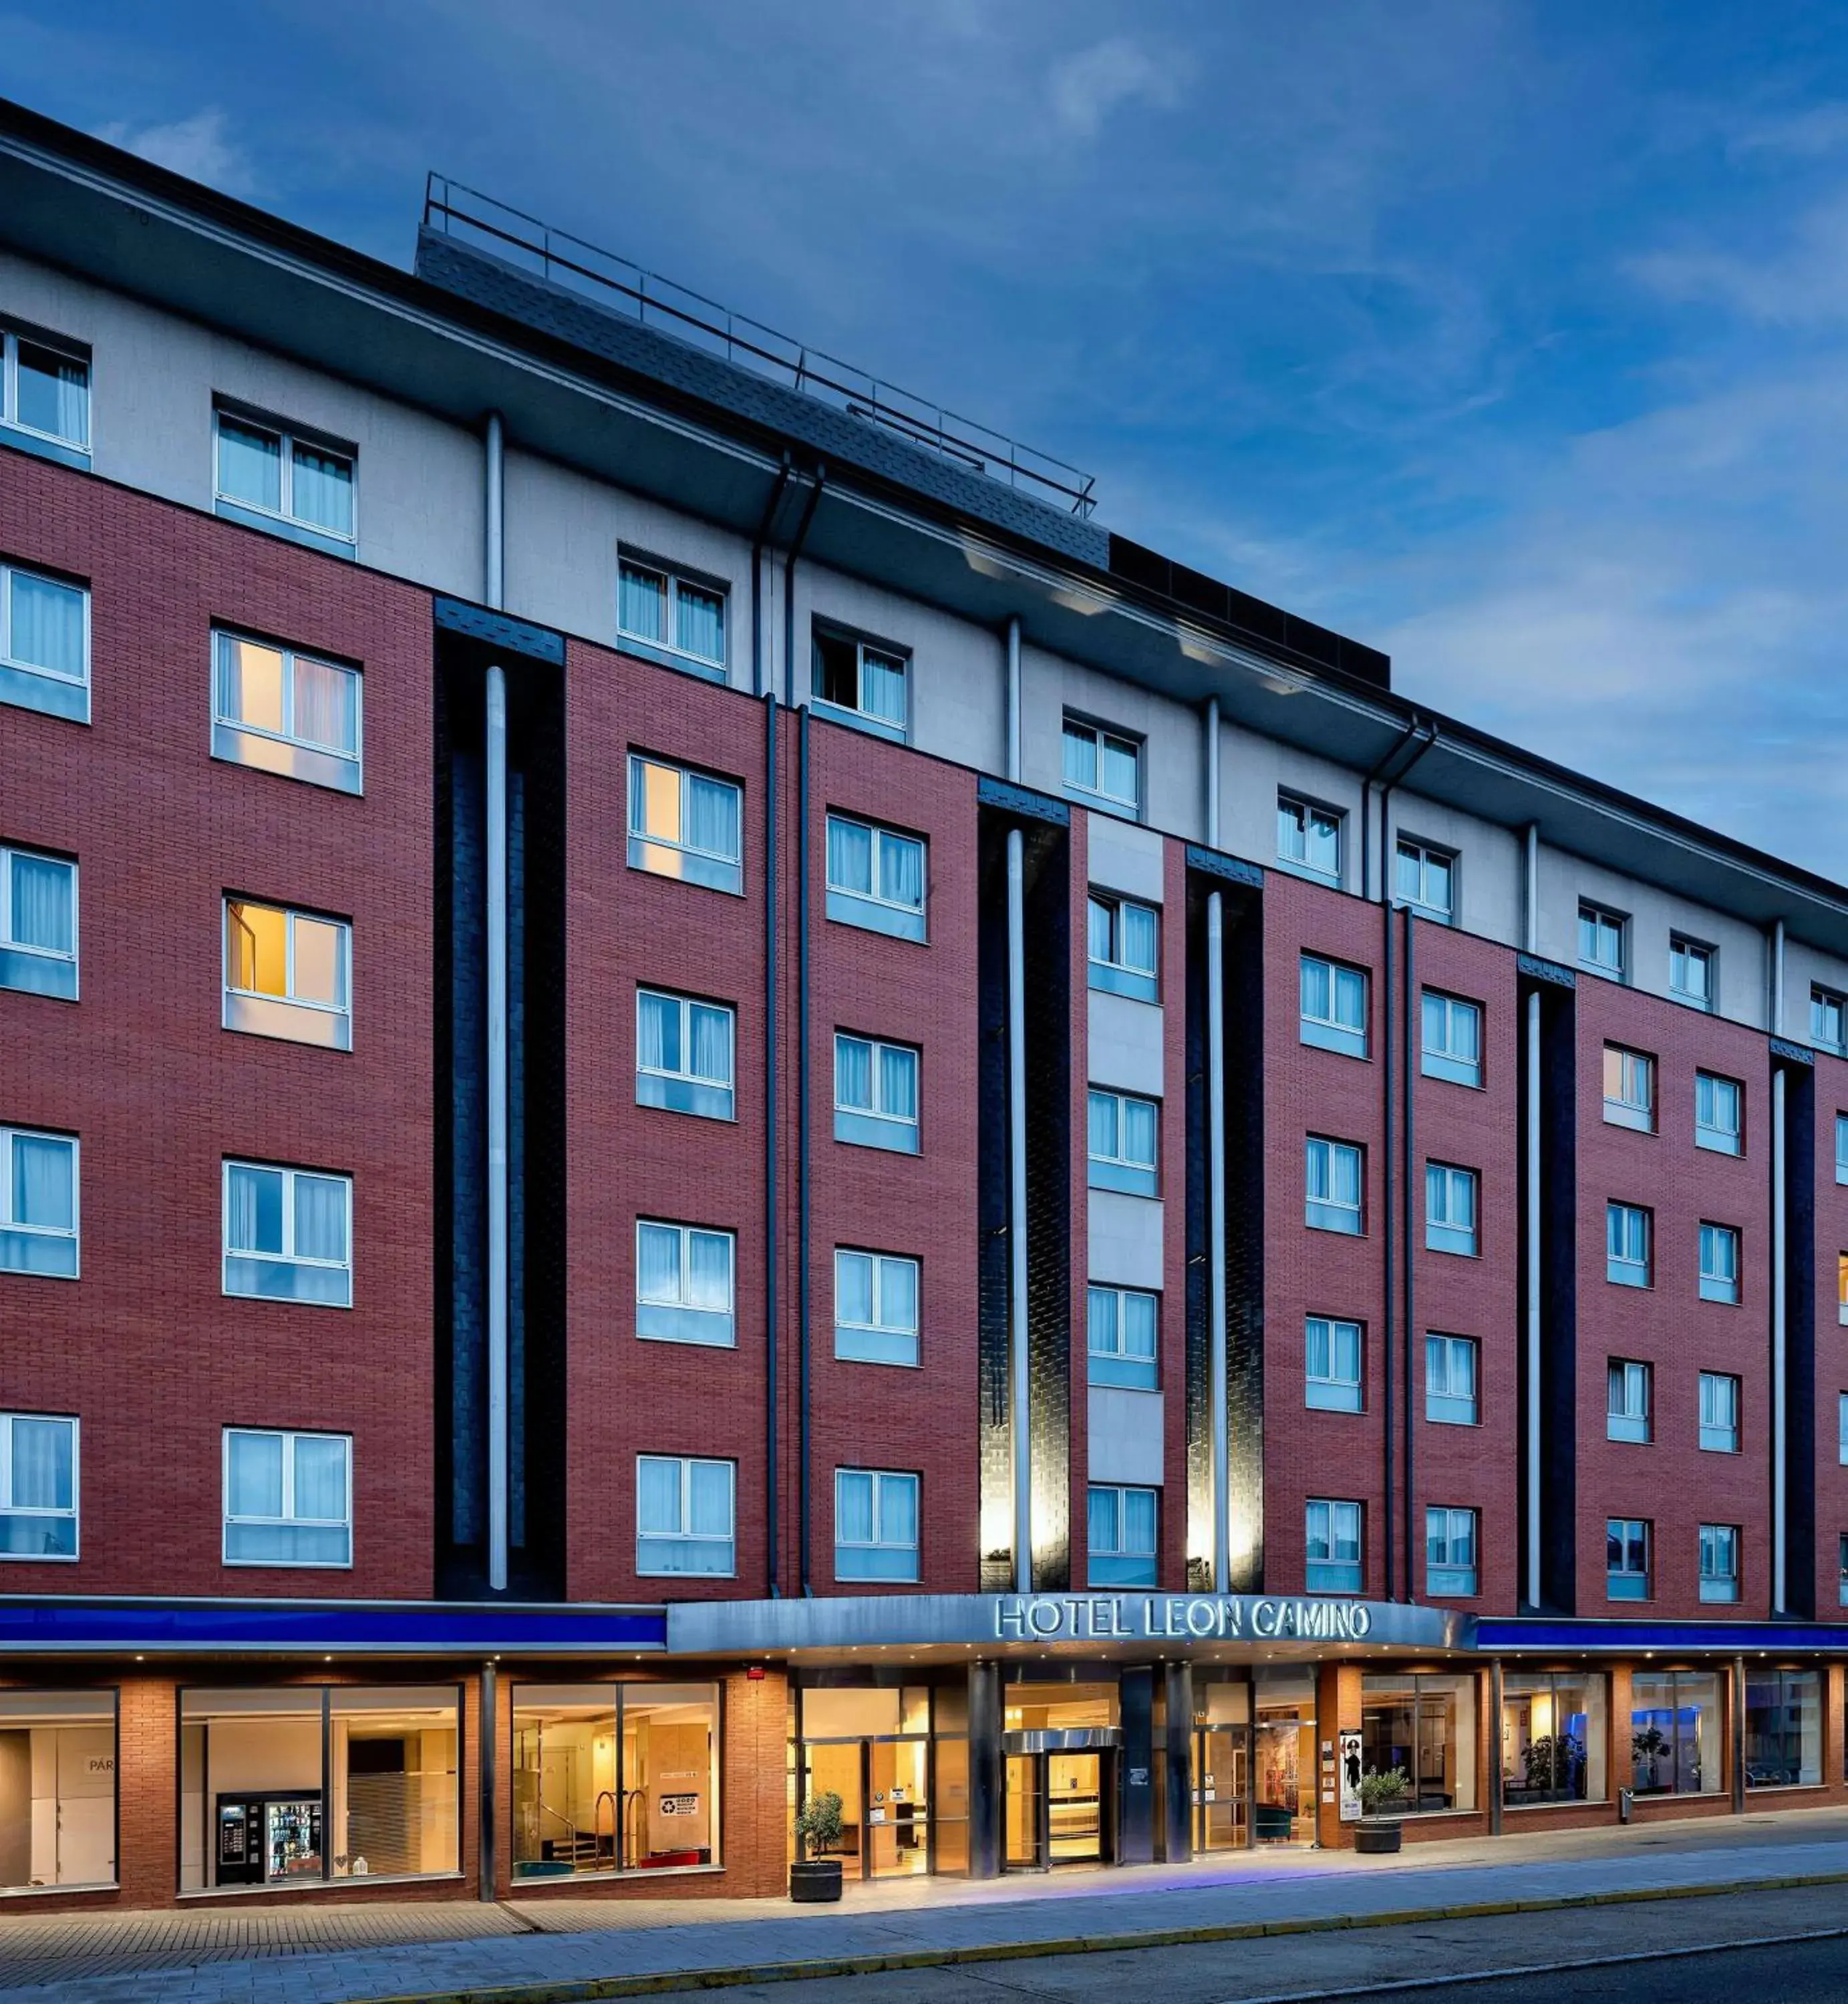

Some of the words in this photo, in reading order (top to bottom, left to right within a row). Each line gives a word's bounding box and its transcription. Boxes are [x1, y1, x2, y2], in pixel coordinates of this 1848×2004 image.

[995, 1597, 1134, 1637] HOTEL
[1144, 1598, 1244, 1637] LEON
[1251, 1599, 1372, 1639] CAMINO
